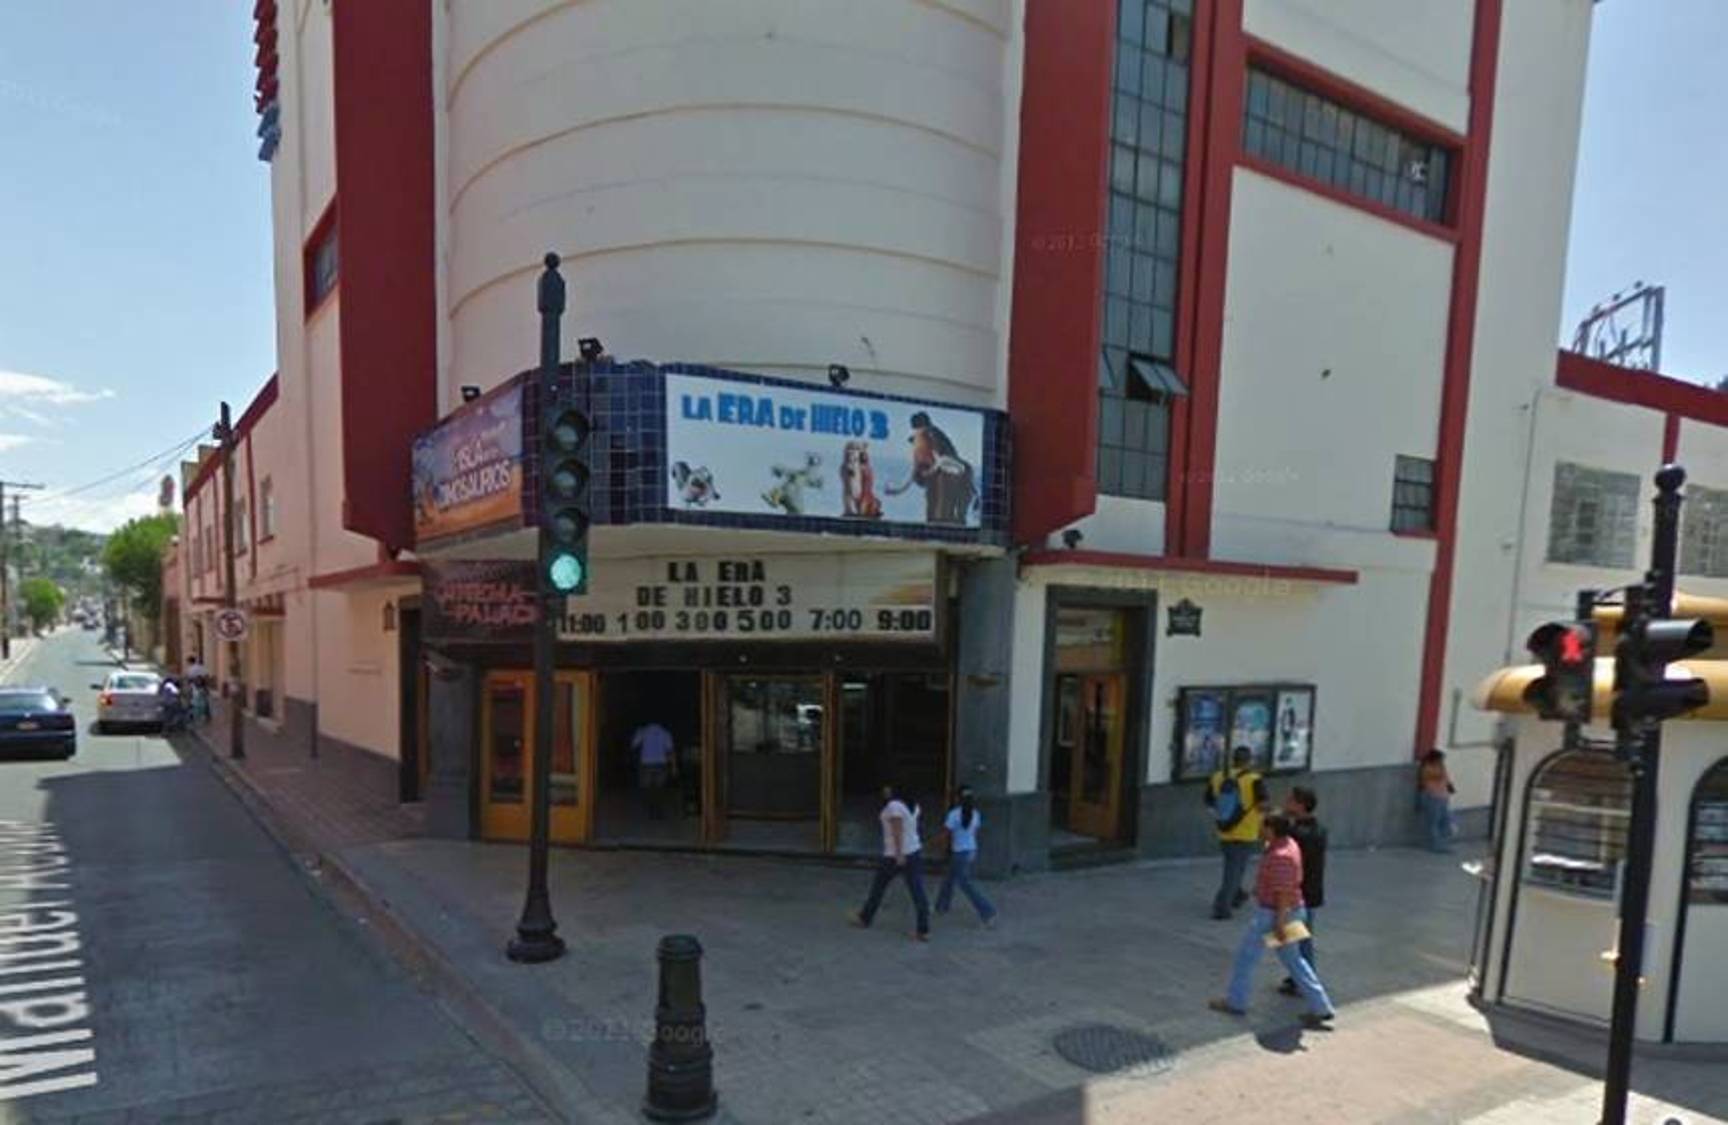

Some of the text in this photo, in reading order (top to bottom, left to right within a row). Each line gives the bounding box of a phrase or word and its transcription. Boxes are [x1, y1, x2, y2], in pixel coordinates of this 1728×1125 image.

[681, 394, 712, 420] LA
[718, 393, 775, 427] ERA
[811, 404, 866, 436] HIELO
[868, 411, 889, 440] 3
[668, 561, 765, 582] LA ERA
[637, 586, 792, 607] DE HIELO 3
[810, 610, 861, 631] 7:00
[877, 610, 931, 631] 9:00
